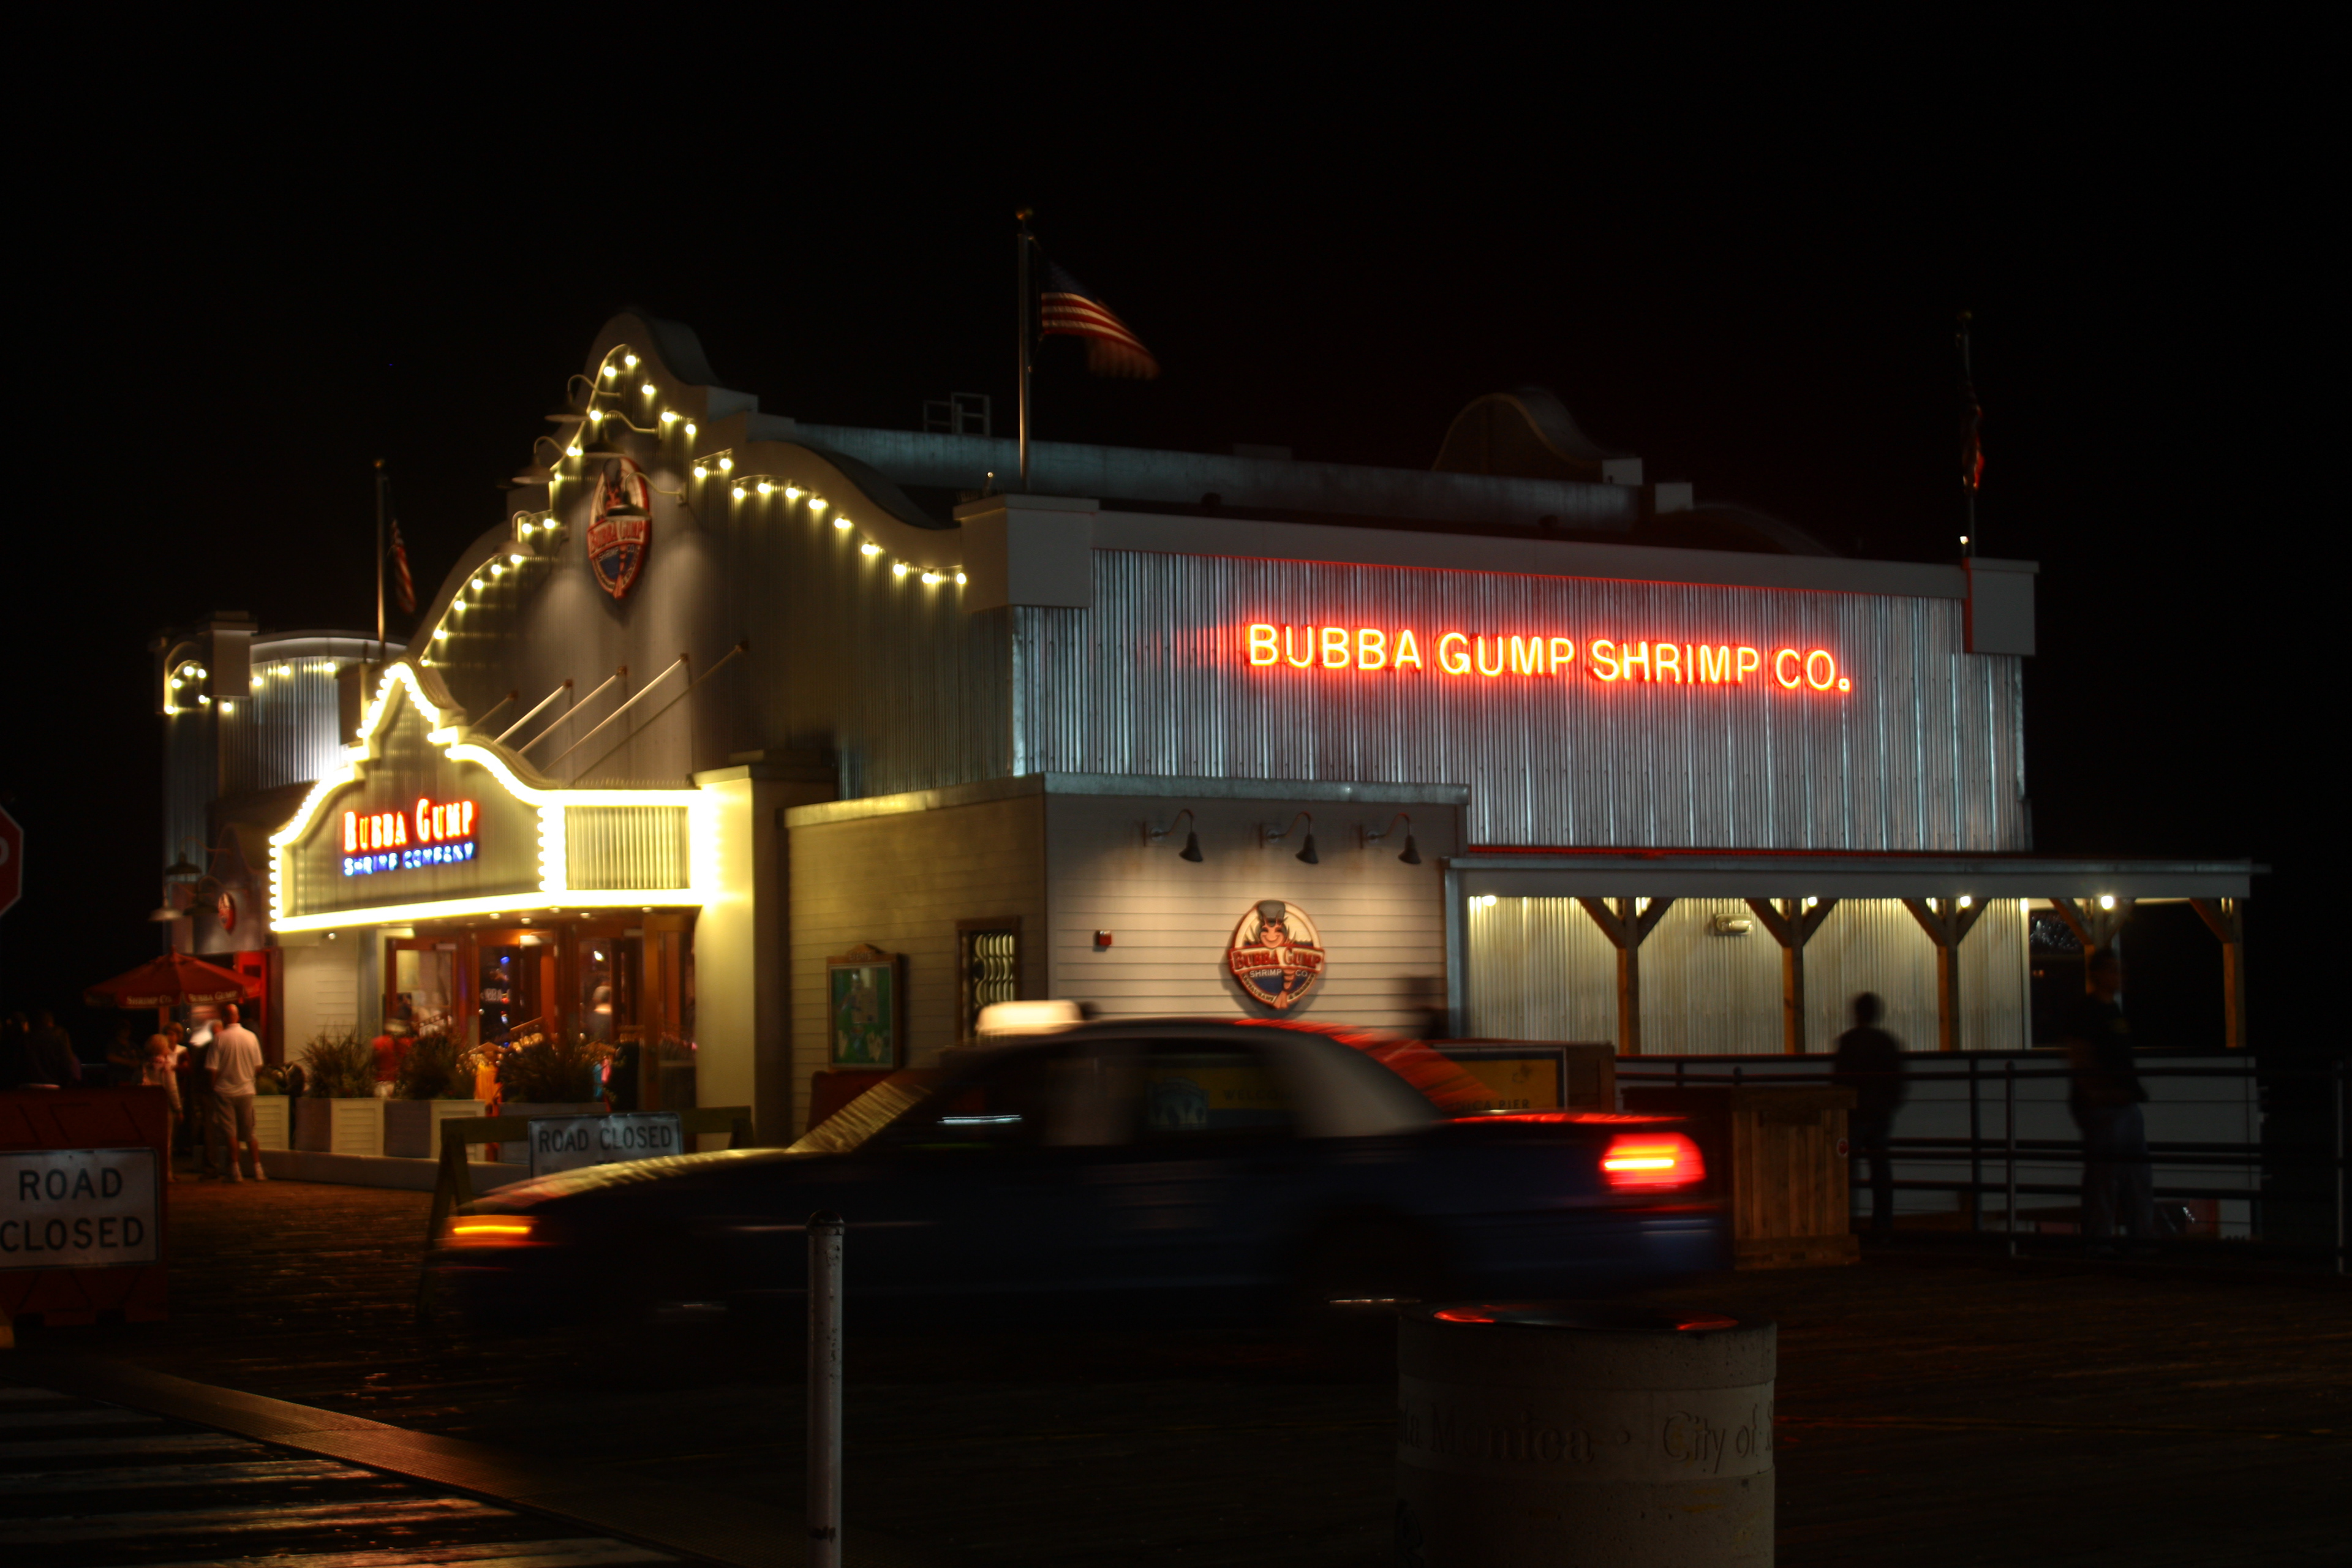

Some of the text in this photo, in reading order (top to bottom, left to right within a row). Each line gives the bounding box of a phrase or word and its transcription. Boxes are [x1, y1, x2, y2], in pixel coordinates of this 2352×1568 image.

[1247, 622, 1850, 692] BUBBA GUMP SHRIMP CO.
[344, 797, 474, 853] BUBBA GUMP
[1233, 946, 1322, 970] BUBBA GUMP
[1250, 968, 1282, 978] SHRIMP
[1498, 1098, 1530, 1109] PIER
[539, 1125, 672, 1153] ROAD CLOSED
[19, 1167, 123, 1200] ROAD
[0, 1216, 144, 1252] CLOSED
[1663, 1410, 1726, 1474] City
[1736, 1403, 1757, 1458] of
